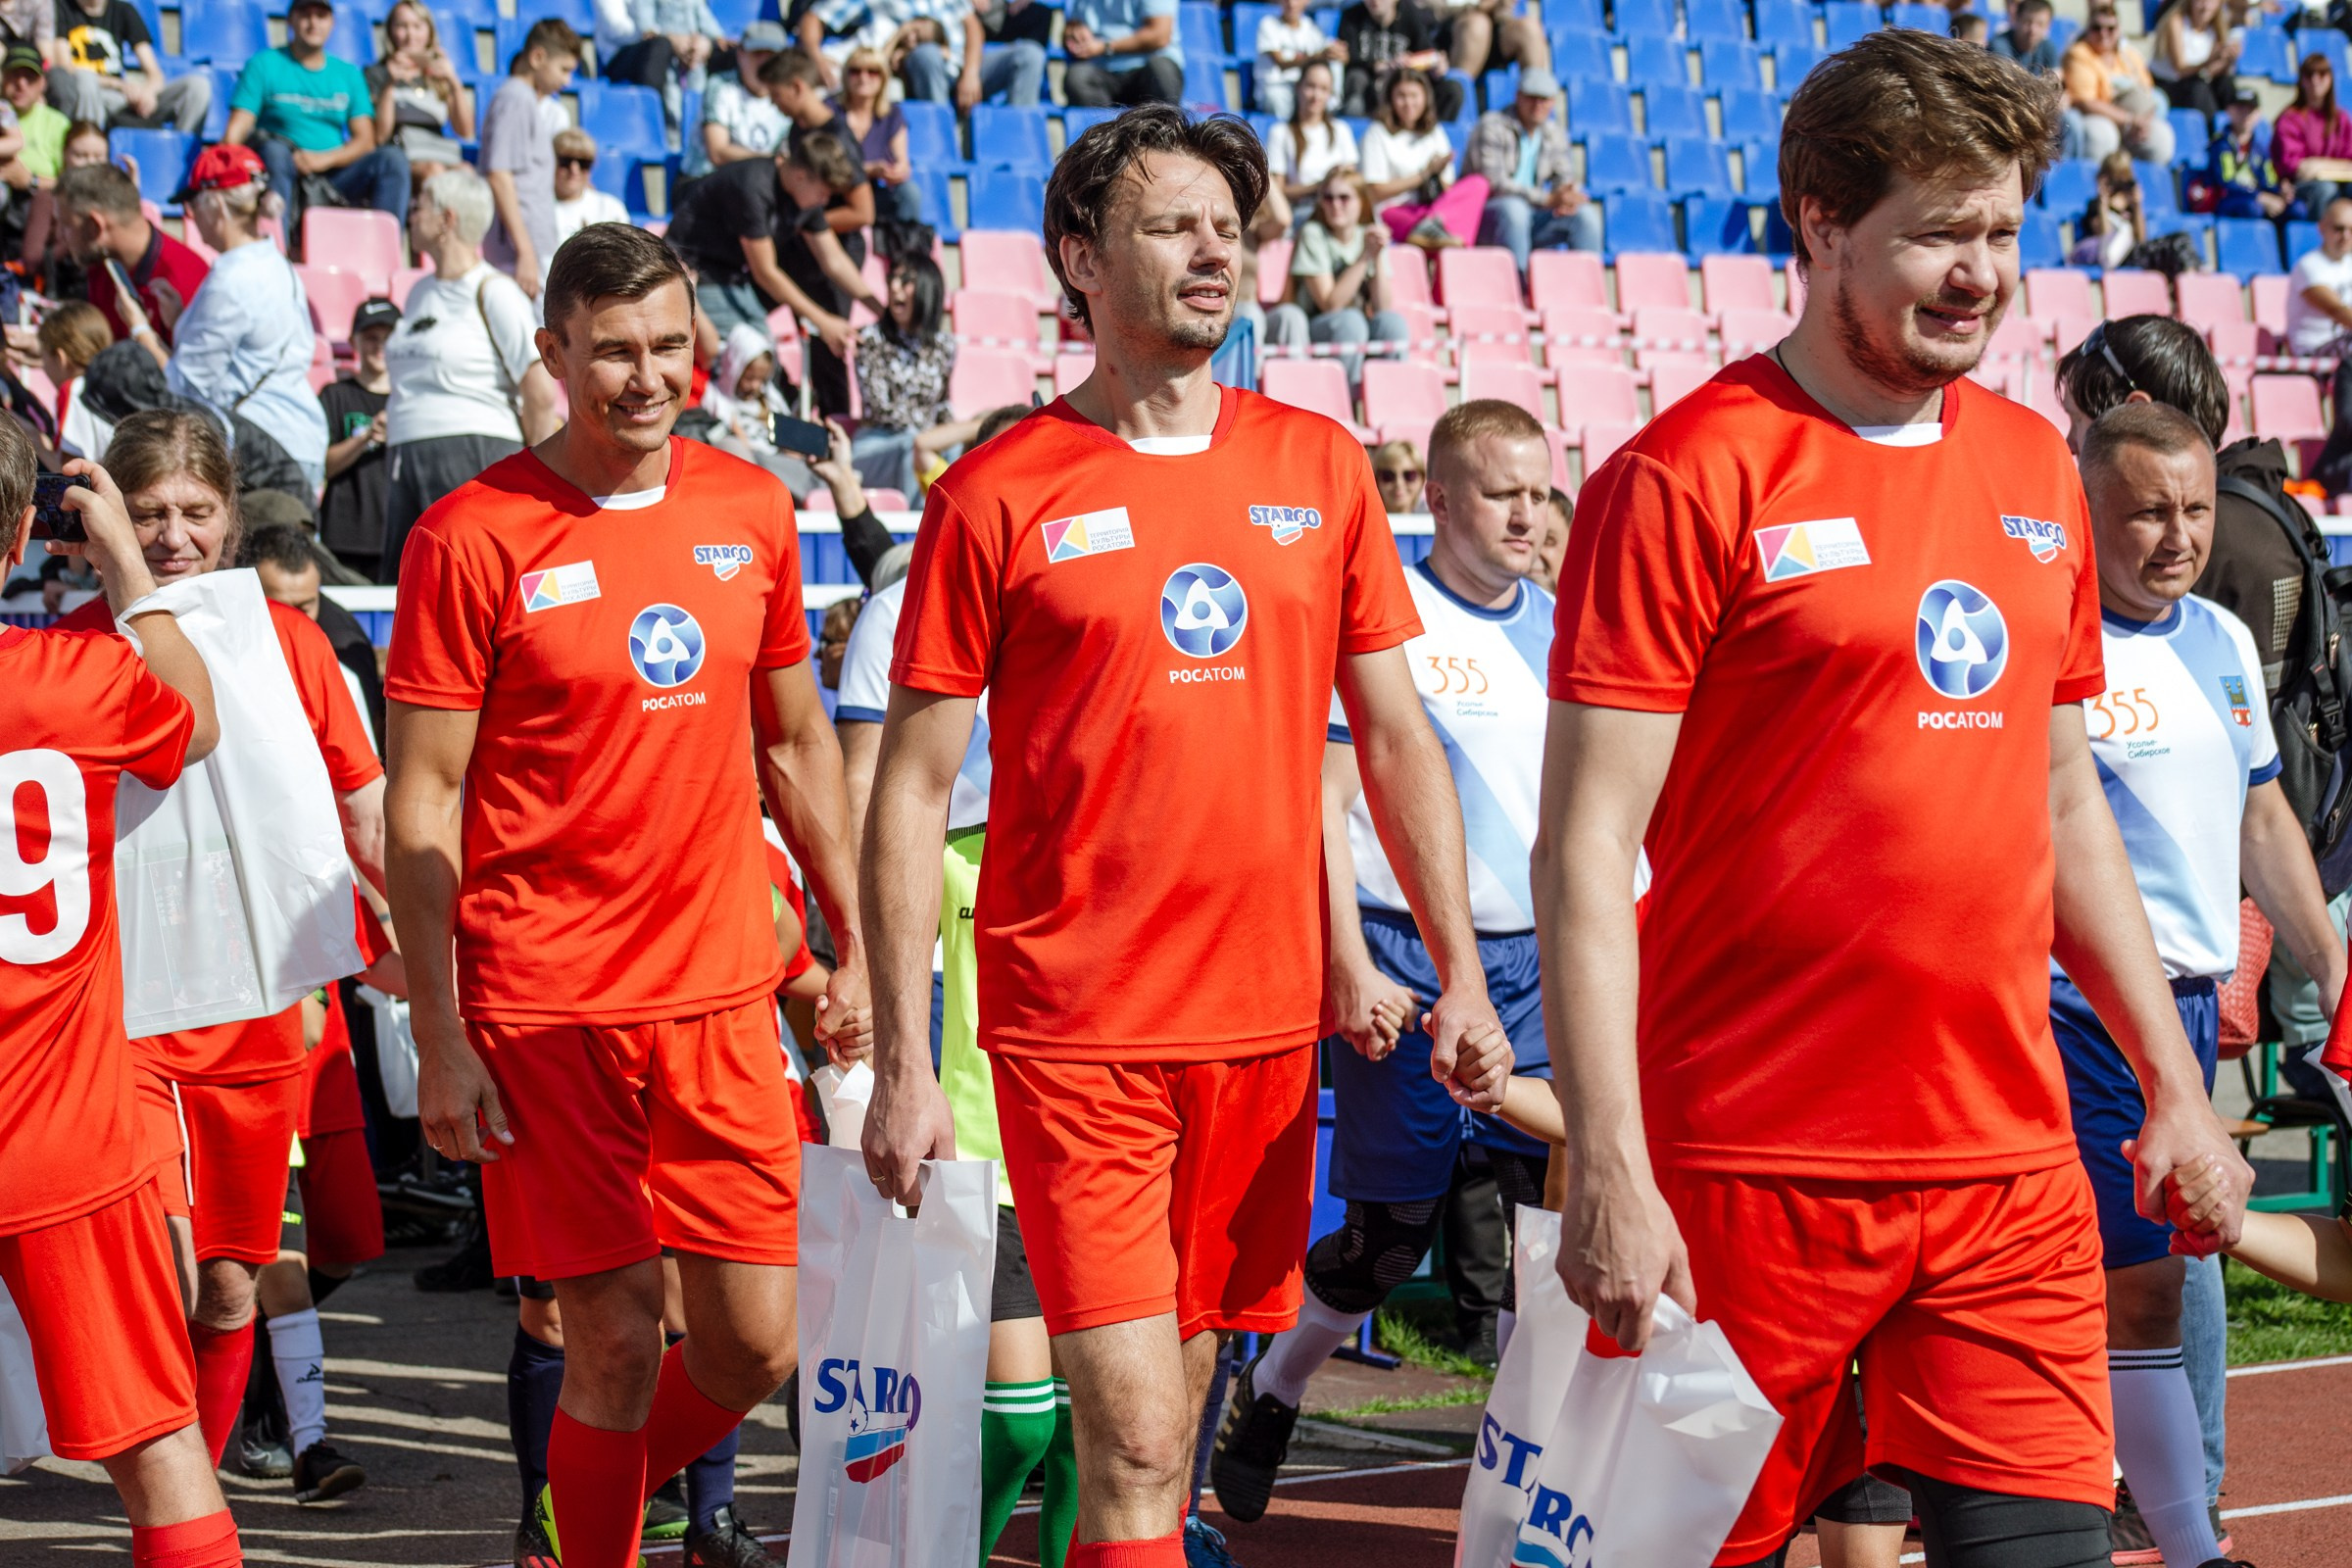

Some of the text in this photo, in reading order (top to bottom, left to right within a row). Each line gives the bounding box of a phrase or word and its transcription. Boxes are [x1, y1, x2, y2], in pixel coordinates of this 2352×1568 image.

[1091, 534, 1130, 545] КУЛЬТУРЫ
[1093, 540, 1132, 552] РОСАТОМА
[1169, 666, 1246, 683] РОСАТОМ
[1427, 657, 1488, 694] 355
[642, 692, 706, 711] РОСАТОМ
[1918, 711, 2003, 729] РОСАТОМ
[2088, 688, 2159, 739] 355
[2128, 747, 2171, 760] Сибирское
[0, 749, 91, 955] 9
